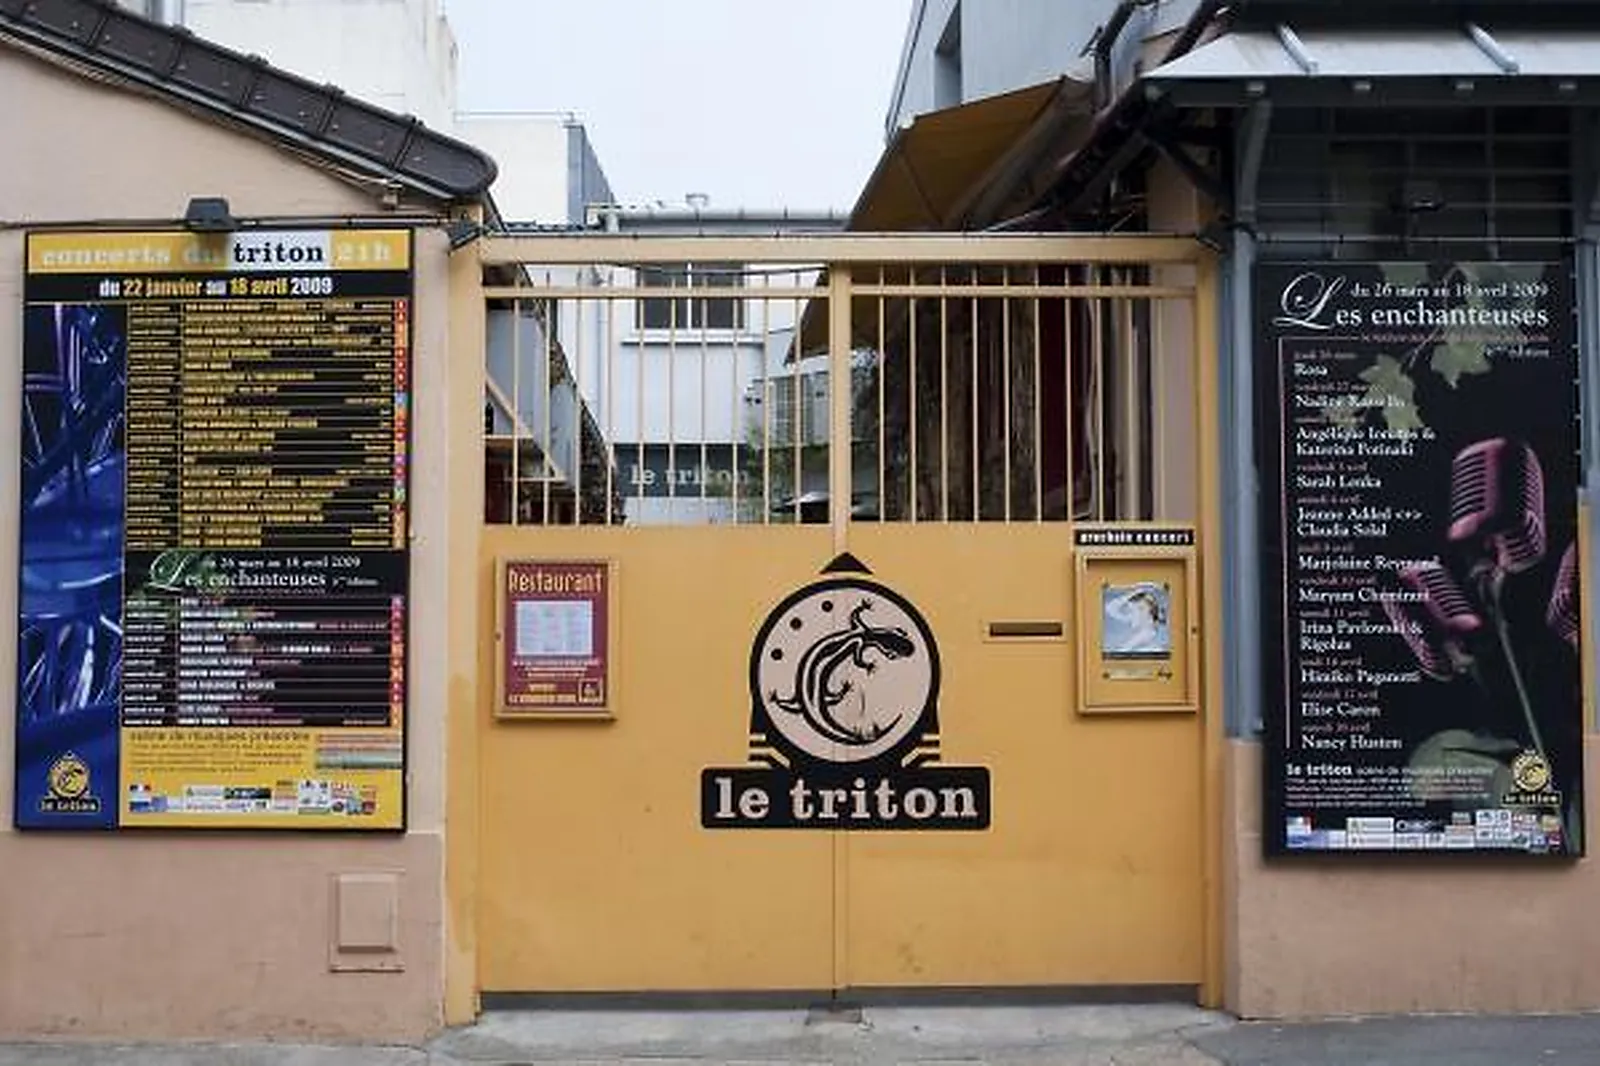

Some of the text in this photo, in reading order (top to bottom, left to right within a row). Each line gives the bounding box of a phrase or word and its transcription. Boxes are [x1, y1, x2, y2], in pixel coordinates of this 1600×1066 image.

[43, 242, 171, 265] concerts
[233, 238, 323, 263] triton
[99, 278, 120, 297] du
[123, 278, 144, 297] 22
[145, 277, 202, 299] janvier
[206, 284, 227, 297] au
[250, 278, 289, 297] avril
[290, 278, 333, 296] 2009
[1350, 283, 1371, 298] du
[1374, 283, 1392, 298] 26
[1395, 286, 1430, 299] mars
[1455, 283, 1472, 299] 18
[1476, 283, 1507, 299] avril
[1512, 283, 1550, 298] 2009
[1272, 272, 1550, 330] Les enchanteuses
[630, 464, 748, 486] le triton
[1136, 532, 1190, 544] concert
[209, 567, 326, 587] enchanteuses
[508, 568, 602, 594] Restaurant
[1301, 734, 1348, 751] Nancy
[1286, 764, 1303, 776] le
[1307, 764, 1352, 776] triton
[714, 777, 979, 820] le triton
